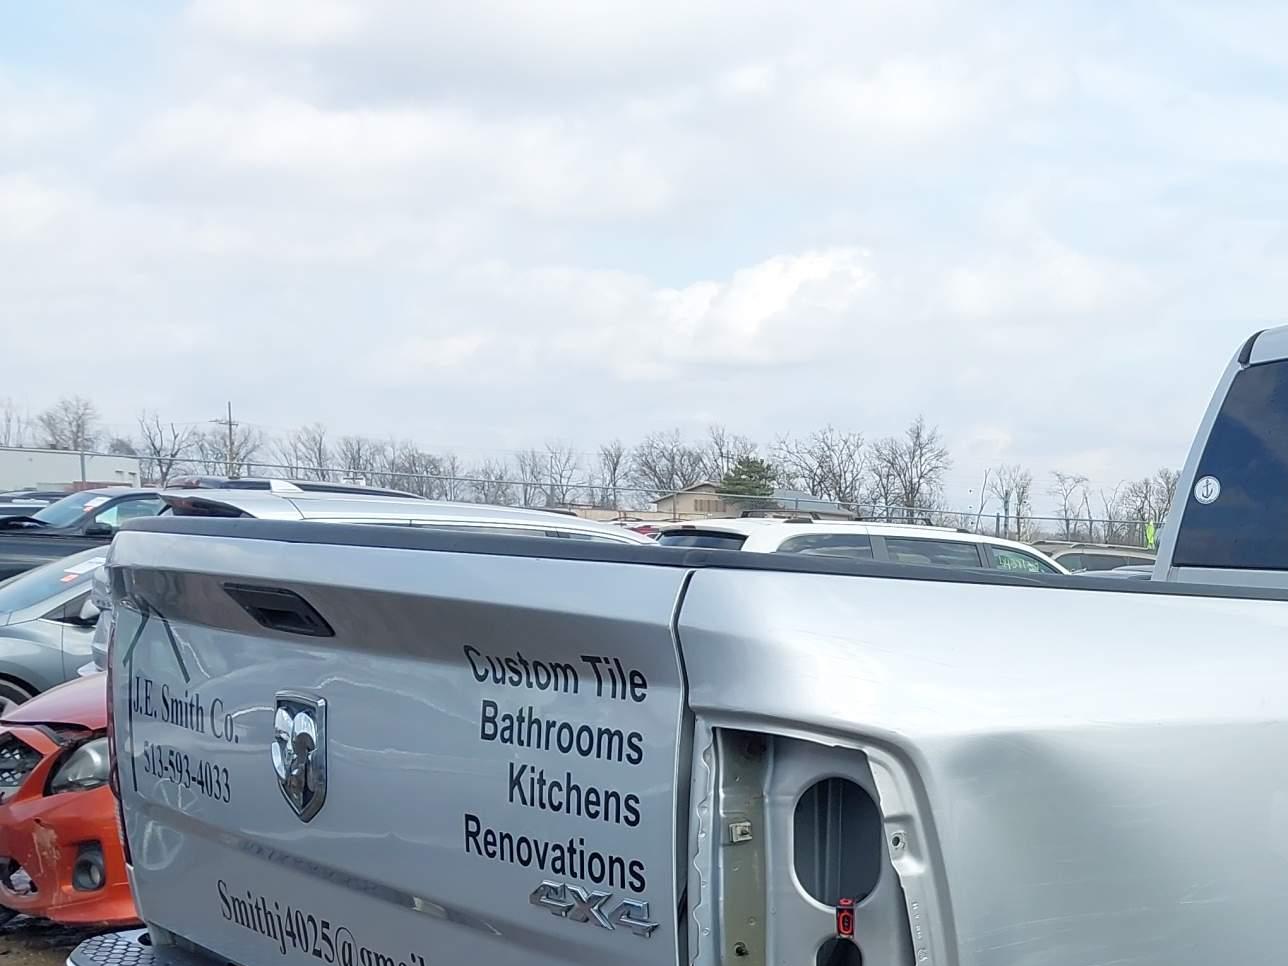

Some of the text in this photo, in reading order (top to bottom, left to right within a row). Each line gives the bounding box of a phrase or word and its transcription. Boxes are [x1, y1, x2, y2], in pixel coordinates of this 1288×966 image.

[463, 644, 648, 703] Custom Tile
[133, 676, 240, 744] J.E. Smith Co.
[480, 699, 644, 765] Bathrooms
[143, 740, 232, 803] 513-593-4033
[508, 762, 641, 827] Kitchens
[464, 813, 646, 893] Renovations
